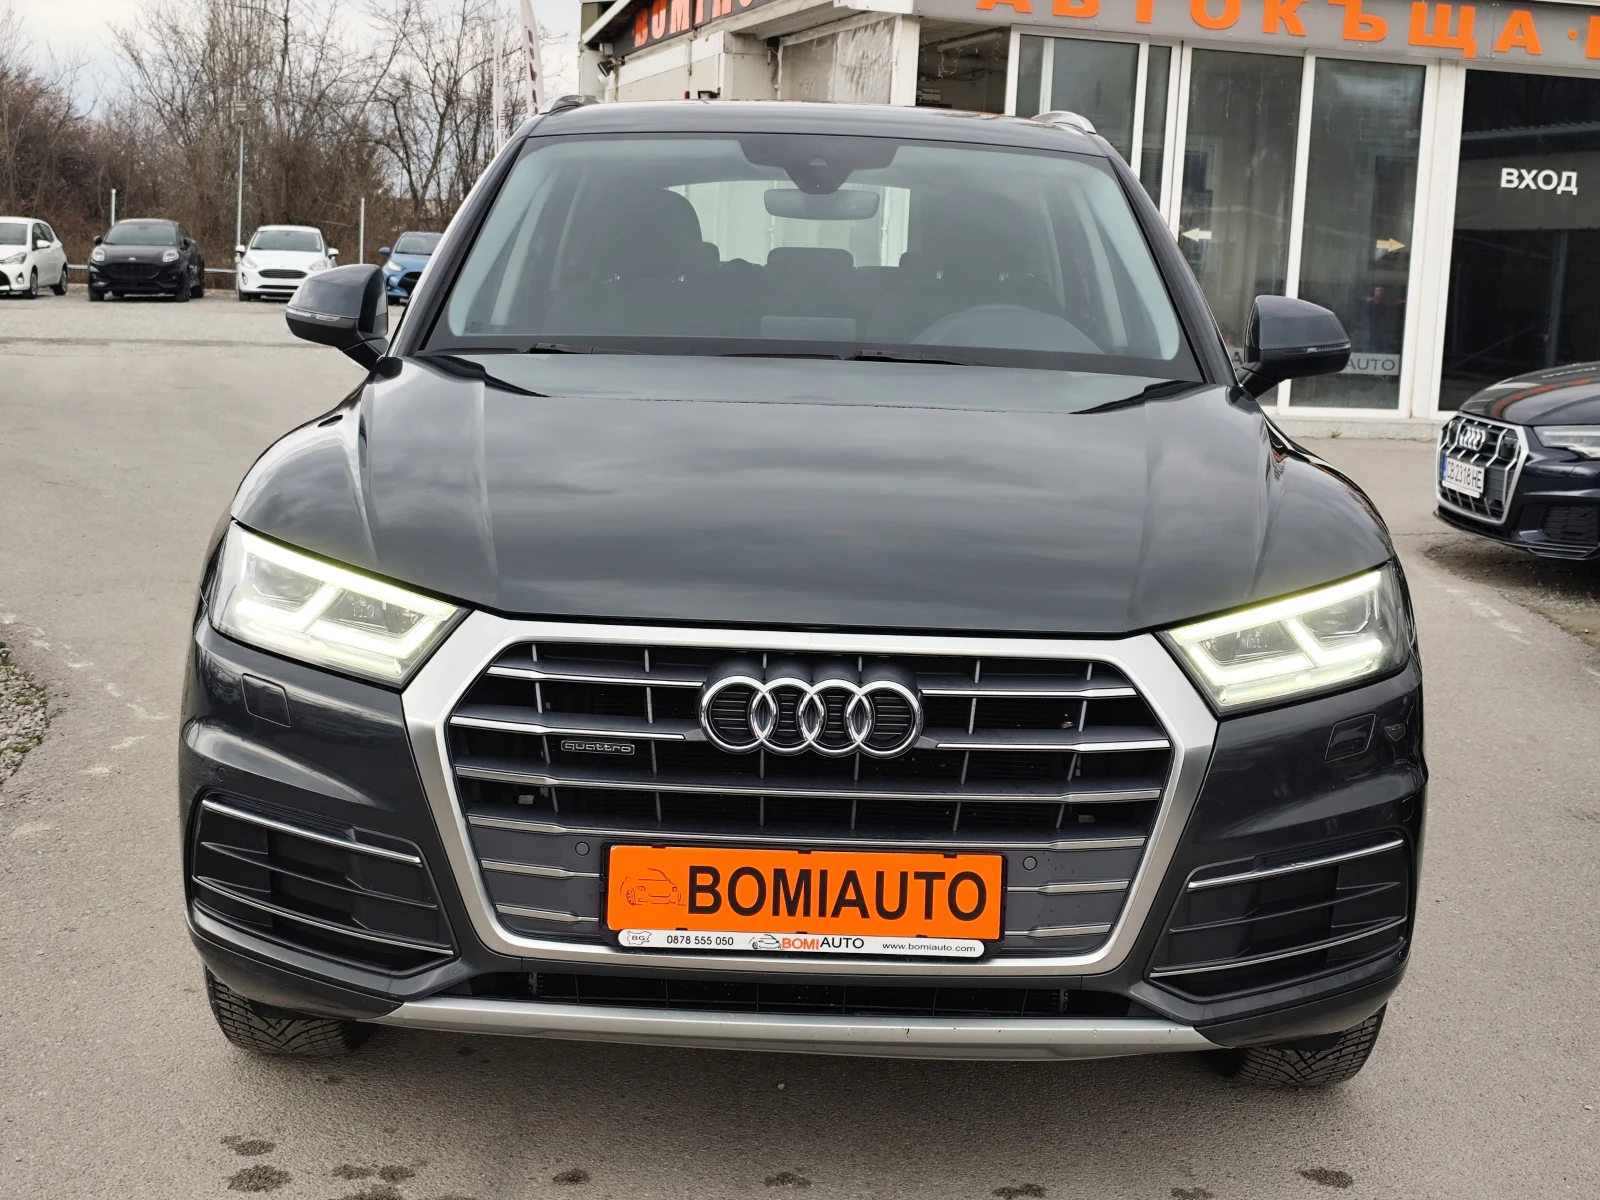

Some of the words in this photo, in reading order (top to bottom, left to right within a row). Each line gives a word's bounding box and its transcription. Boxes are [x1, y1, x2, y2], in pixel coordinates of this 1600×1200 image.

[1500, 167, 1578, 196] ВХОД
[564, 743, 631, 752] quattro
[687, 865, 988, 922] BOMIAUTO
[666, 934, 691, 945] 0878
[694, 935, 713, 946] 555
[715, 936, 734, 946] 050
[882, 941, 976, 953] www.bomiauto.com
